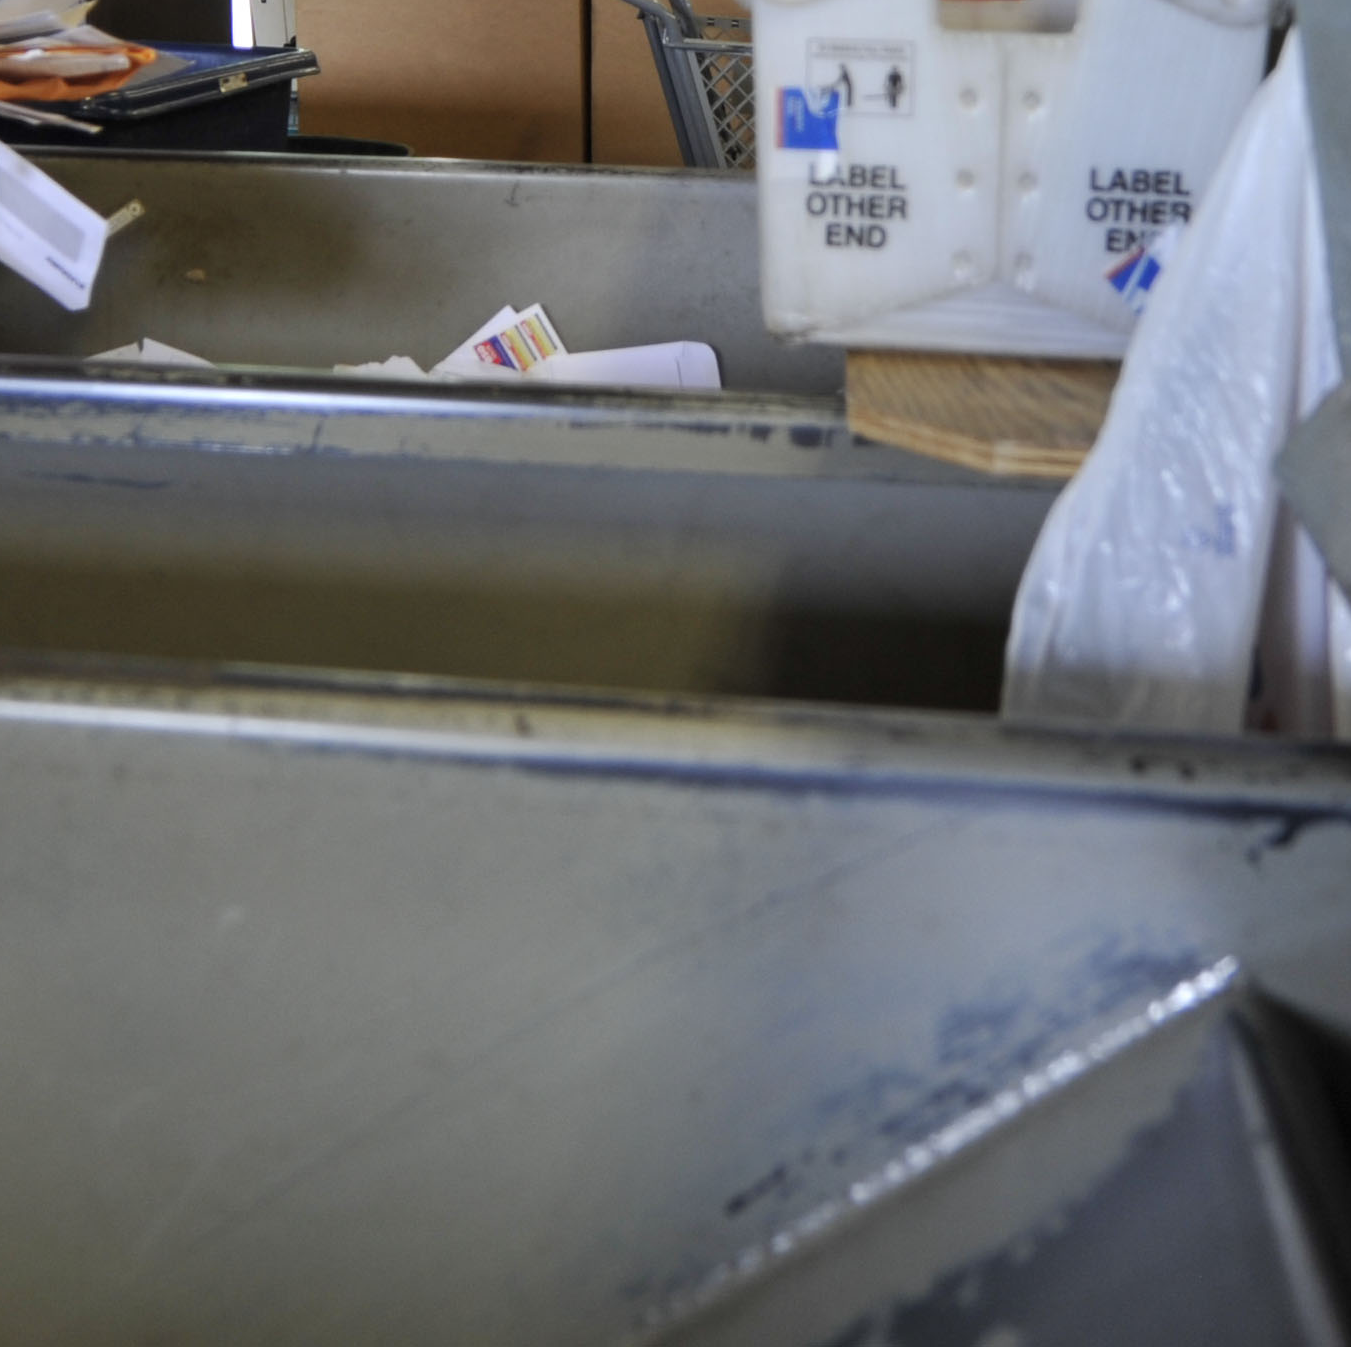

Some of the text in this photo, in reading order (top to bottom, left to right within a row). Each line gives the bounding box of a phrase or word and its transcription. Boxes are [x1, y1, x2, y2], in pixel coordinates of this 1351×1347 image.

[808, 161, 907, 191] LABEL
[1089, 167, 1191, 197] LABEL
[806, 192, 909, 220] OTHER
[1085, 197, 1193, 226] OTHER
[825, 222, 888, 249] END
[1105, 227, 1158, 253] EN
